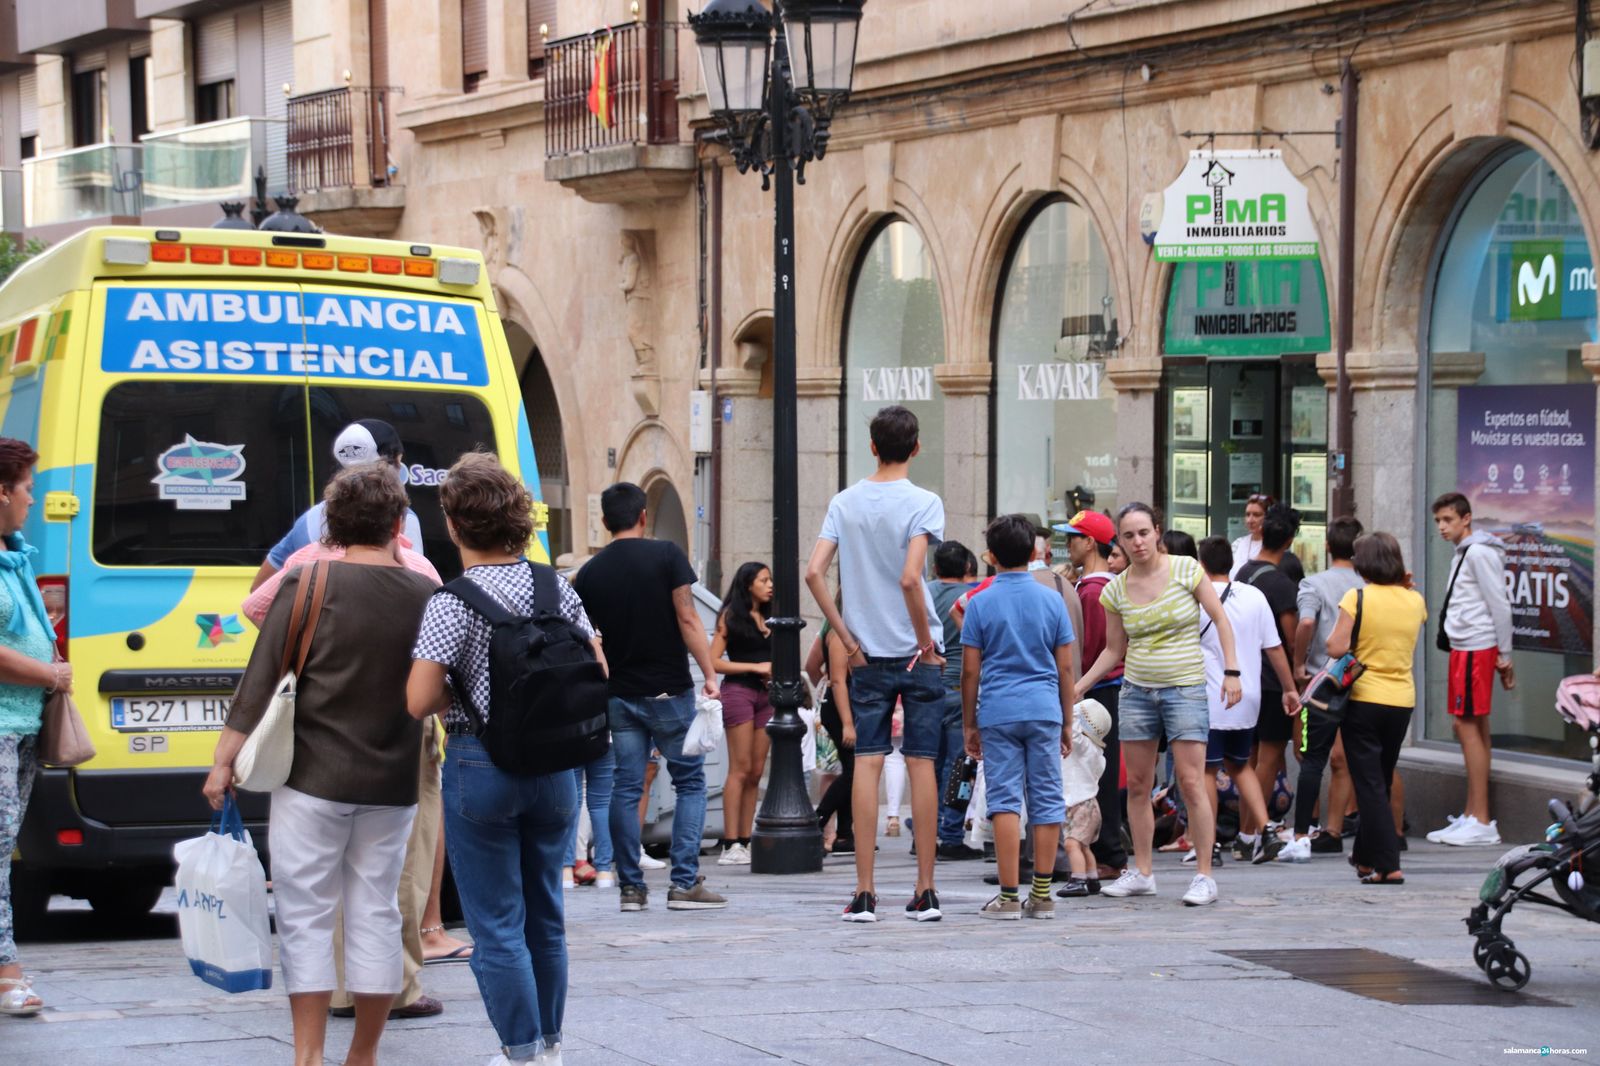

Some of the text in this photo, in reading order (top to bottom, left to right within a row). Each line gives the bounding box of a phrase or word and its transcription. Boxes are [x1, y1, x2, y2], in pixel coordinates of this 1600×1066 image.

[1187, 226, 1286, 238] INMOBILIARIOS
[127, 292, 466, 335] AMBULANCIA
[1195, 312, 1297, 335] INMOBILIARIOS
[130, 340, 468, 381] ASISTENCIAL
[863, 367, 933, 401] KAVARI
[1018, 363, 1099, 400] KAVARI
[1485, 411, 1525, 430] Expertos
[1526, 414, 1538, 426] en
[1471, 430, 1586, 446] Movistar es vuestra casa.
[411, 465, 448, 485] Sac
[1504, 569, 1570, 609] RATIS
[144, 677, 233, 687] MASTER
[130, 700, 189, 723] 5271
[202, 698, 231, 721] HN
[132, 736, 165, 752] SP
